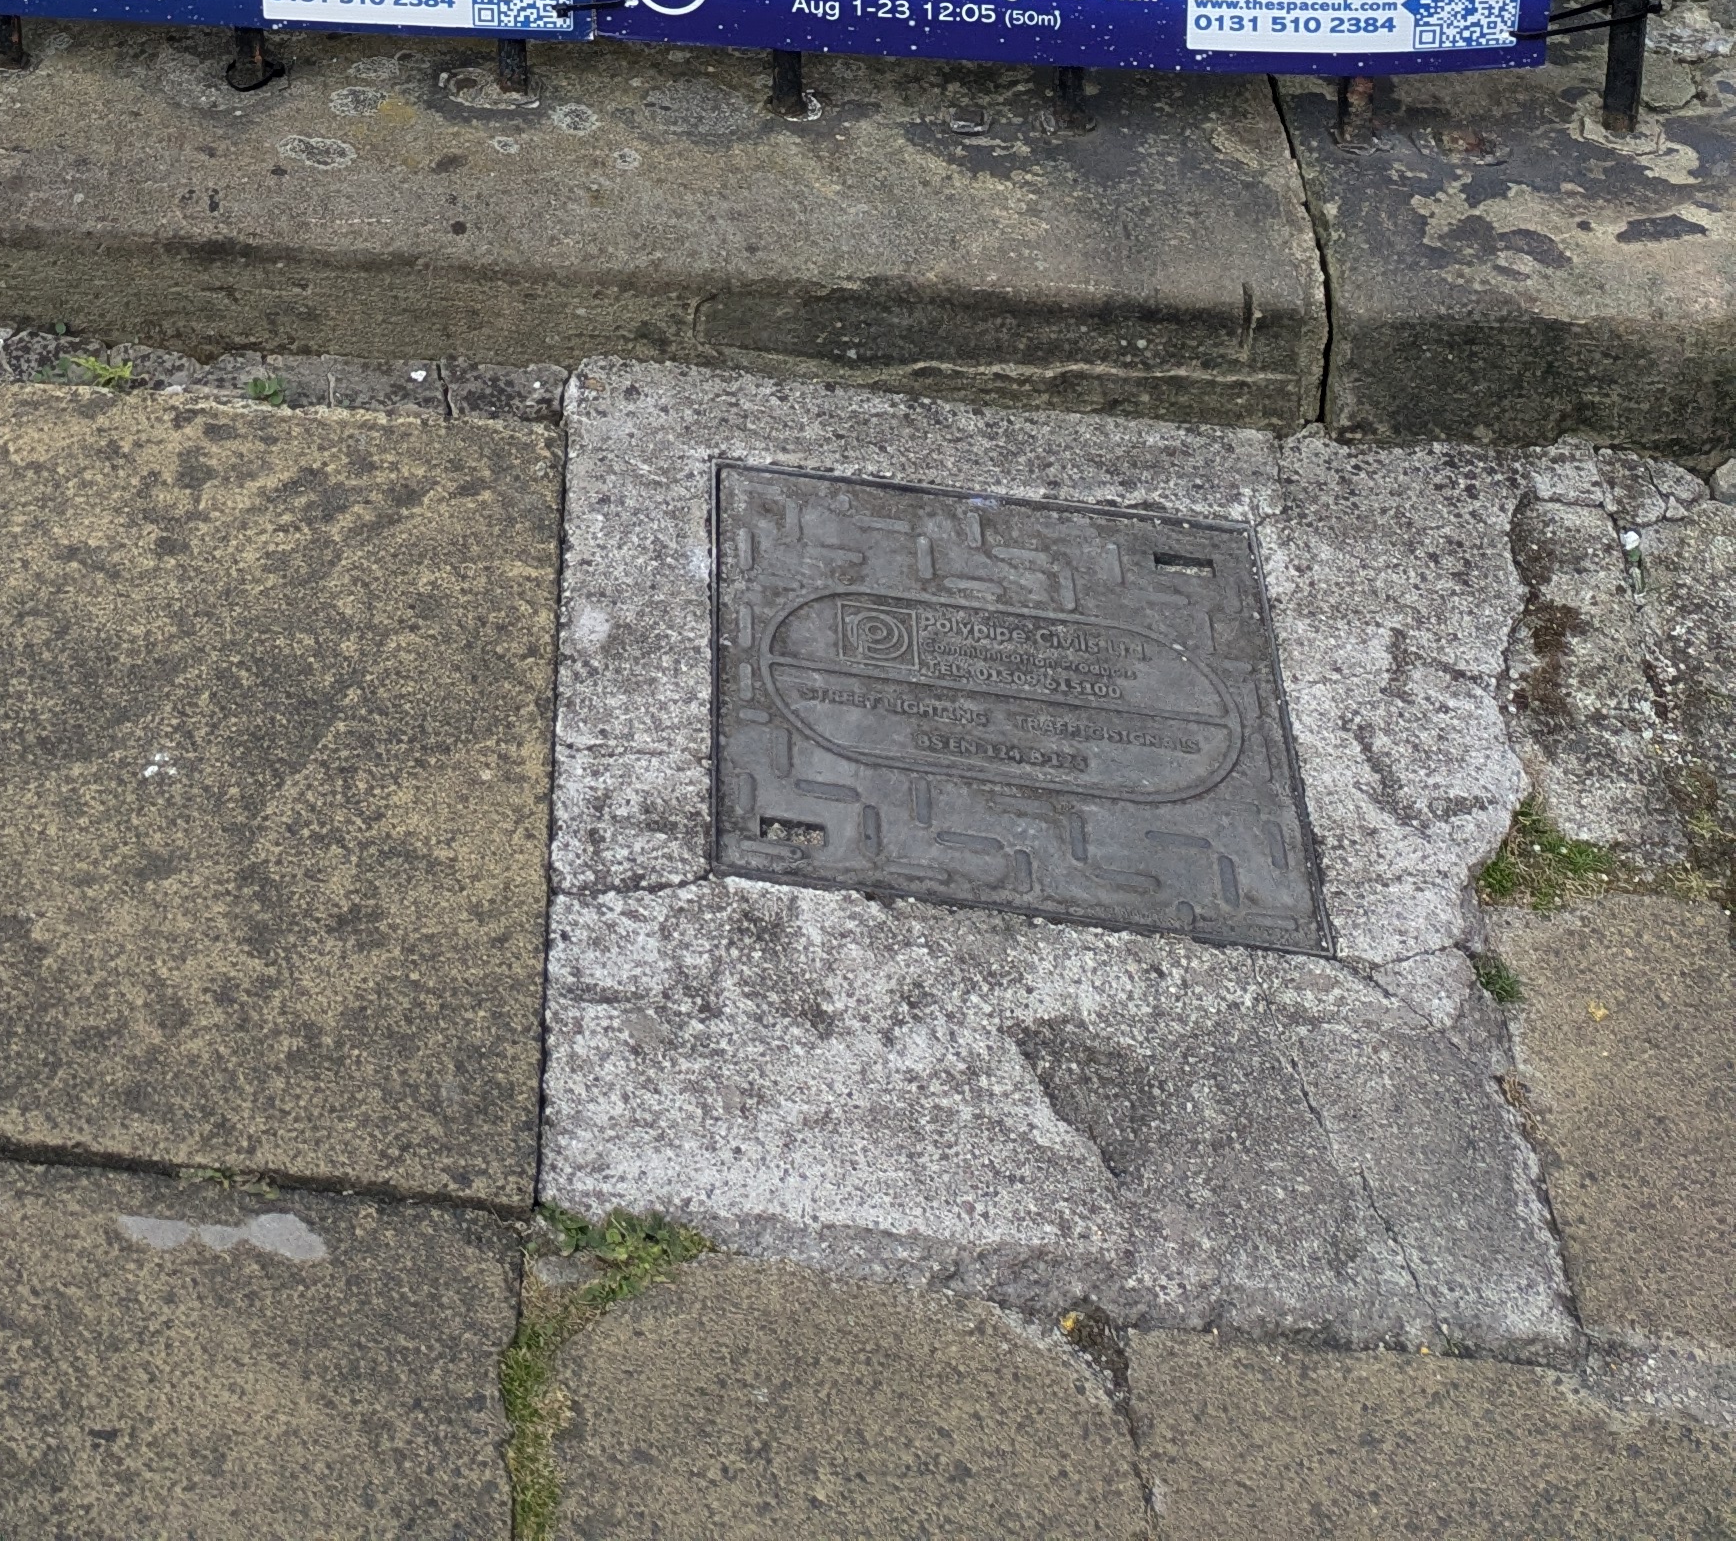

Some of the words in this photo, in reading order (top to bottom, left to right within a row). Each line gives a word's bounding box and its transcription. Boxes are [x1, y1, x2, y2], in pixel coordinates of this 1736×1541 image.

[853, 0, 913, 20] 1-23
[924, 2, 996, 23] 12:05
[1005, 7, 1061, 31] (50m)
[921, 614, 1027, 644] Polypipe
[923, 639, 1058, 669] Communication
[800, 687, 882, 709] STREET
[884, 697, 988, 727] LIGHTING
